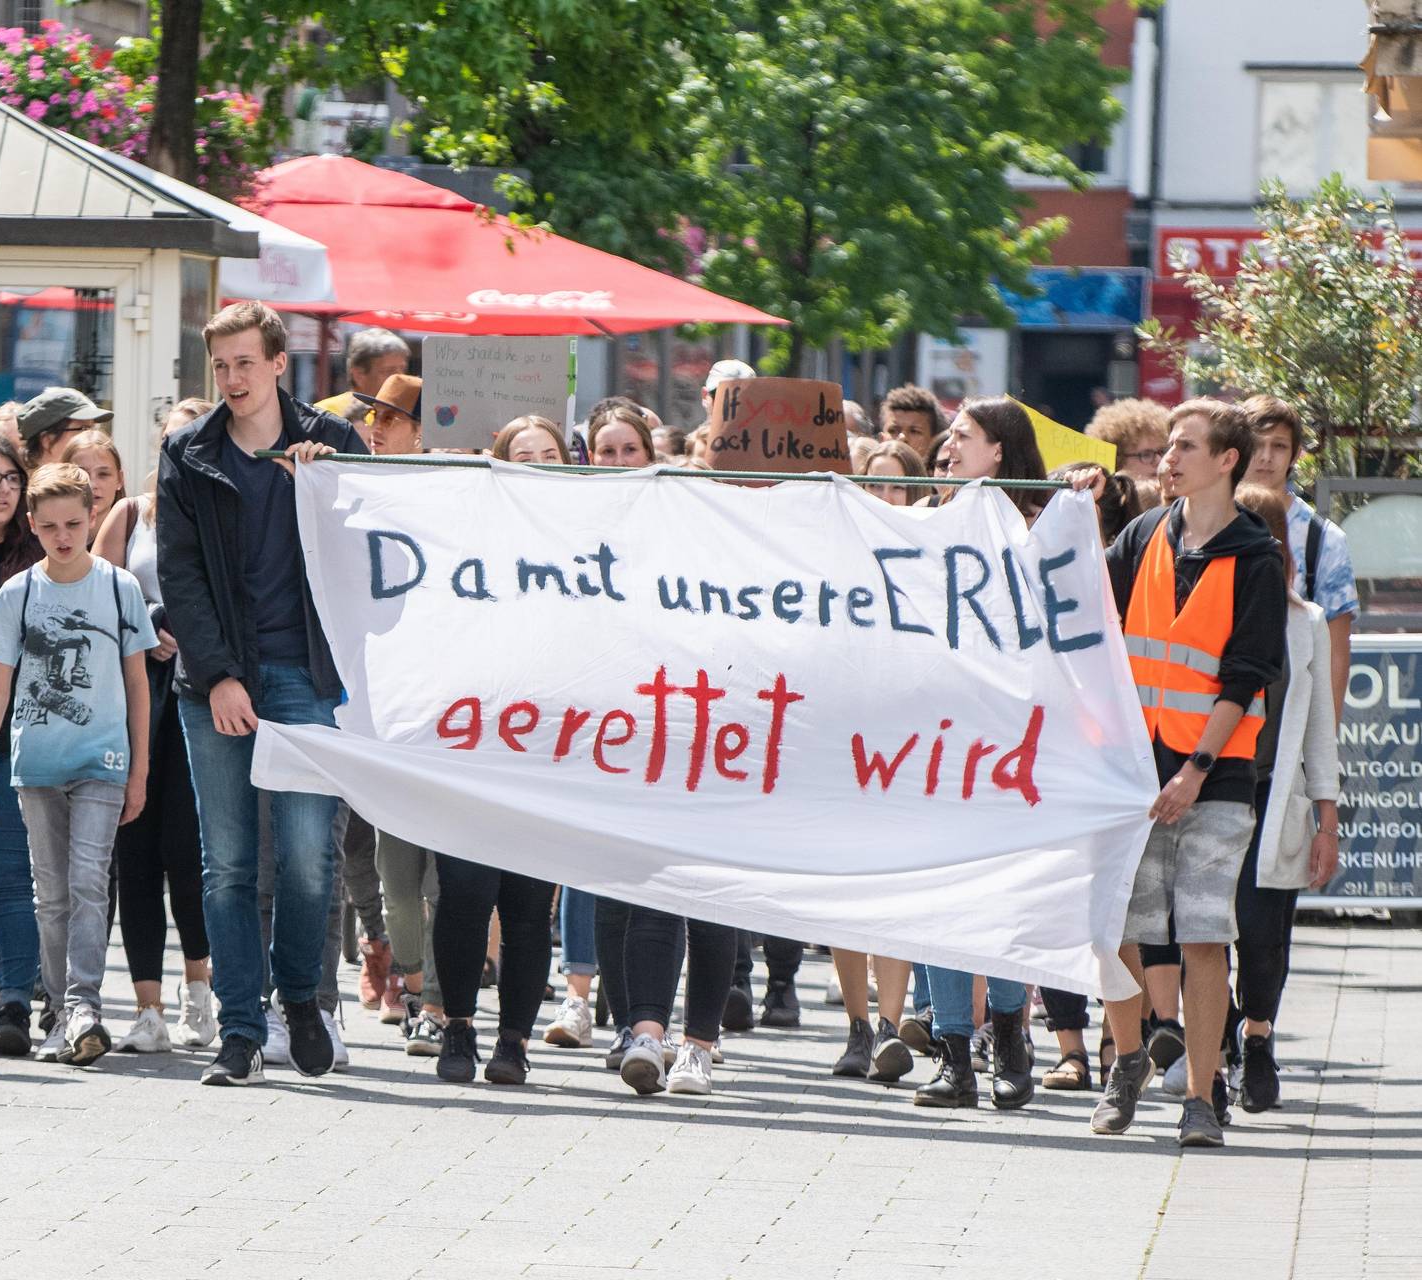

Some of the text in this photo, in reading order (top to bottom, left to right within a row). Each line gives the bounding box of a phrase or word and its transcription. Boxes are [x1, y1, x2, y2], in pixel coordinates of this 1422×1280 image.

[813, 391, 845, 427] don
[710, 429, 751, 452] act
[656, 575, 875, 628] unsere
[872, 545, 1105, 653] ERLE
[1343, 663, 1422, 710] OL
[436, 663, 1045, 808] gerettet wird
[1336, 721, 1422, 746] NKAU
[104, 750, 125, 770] 93
[1336, 790, 1422, 809] AHNGOL
[1336, 822, 1422, 839] RUCHGOL
[1344, 881, 1415, 897] SILBER
